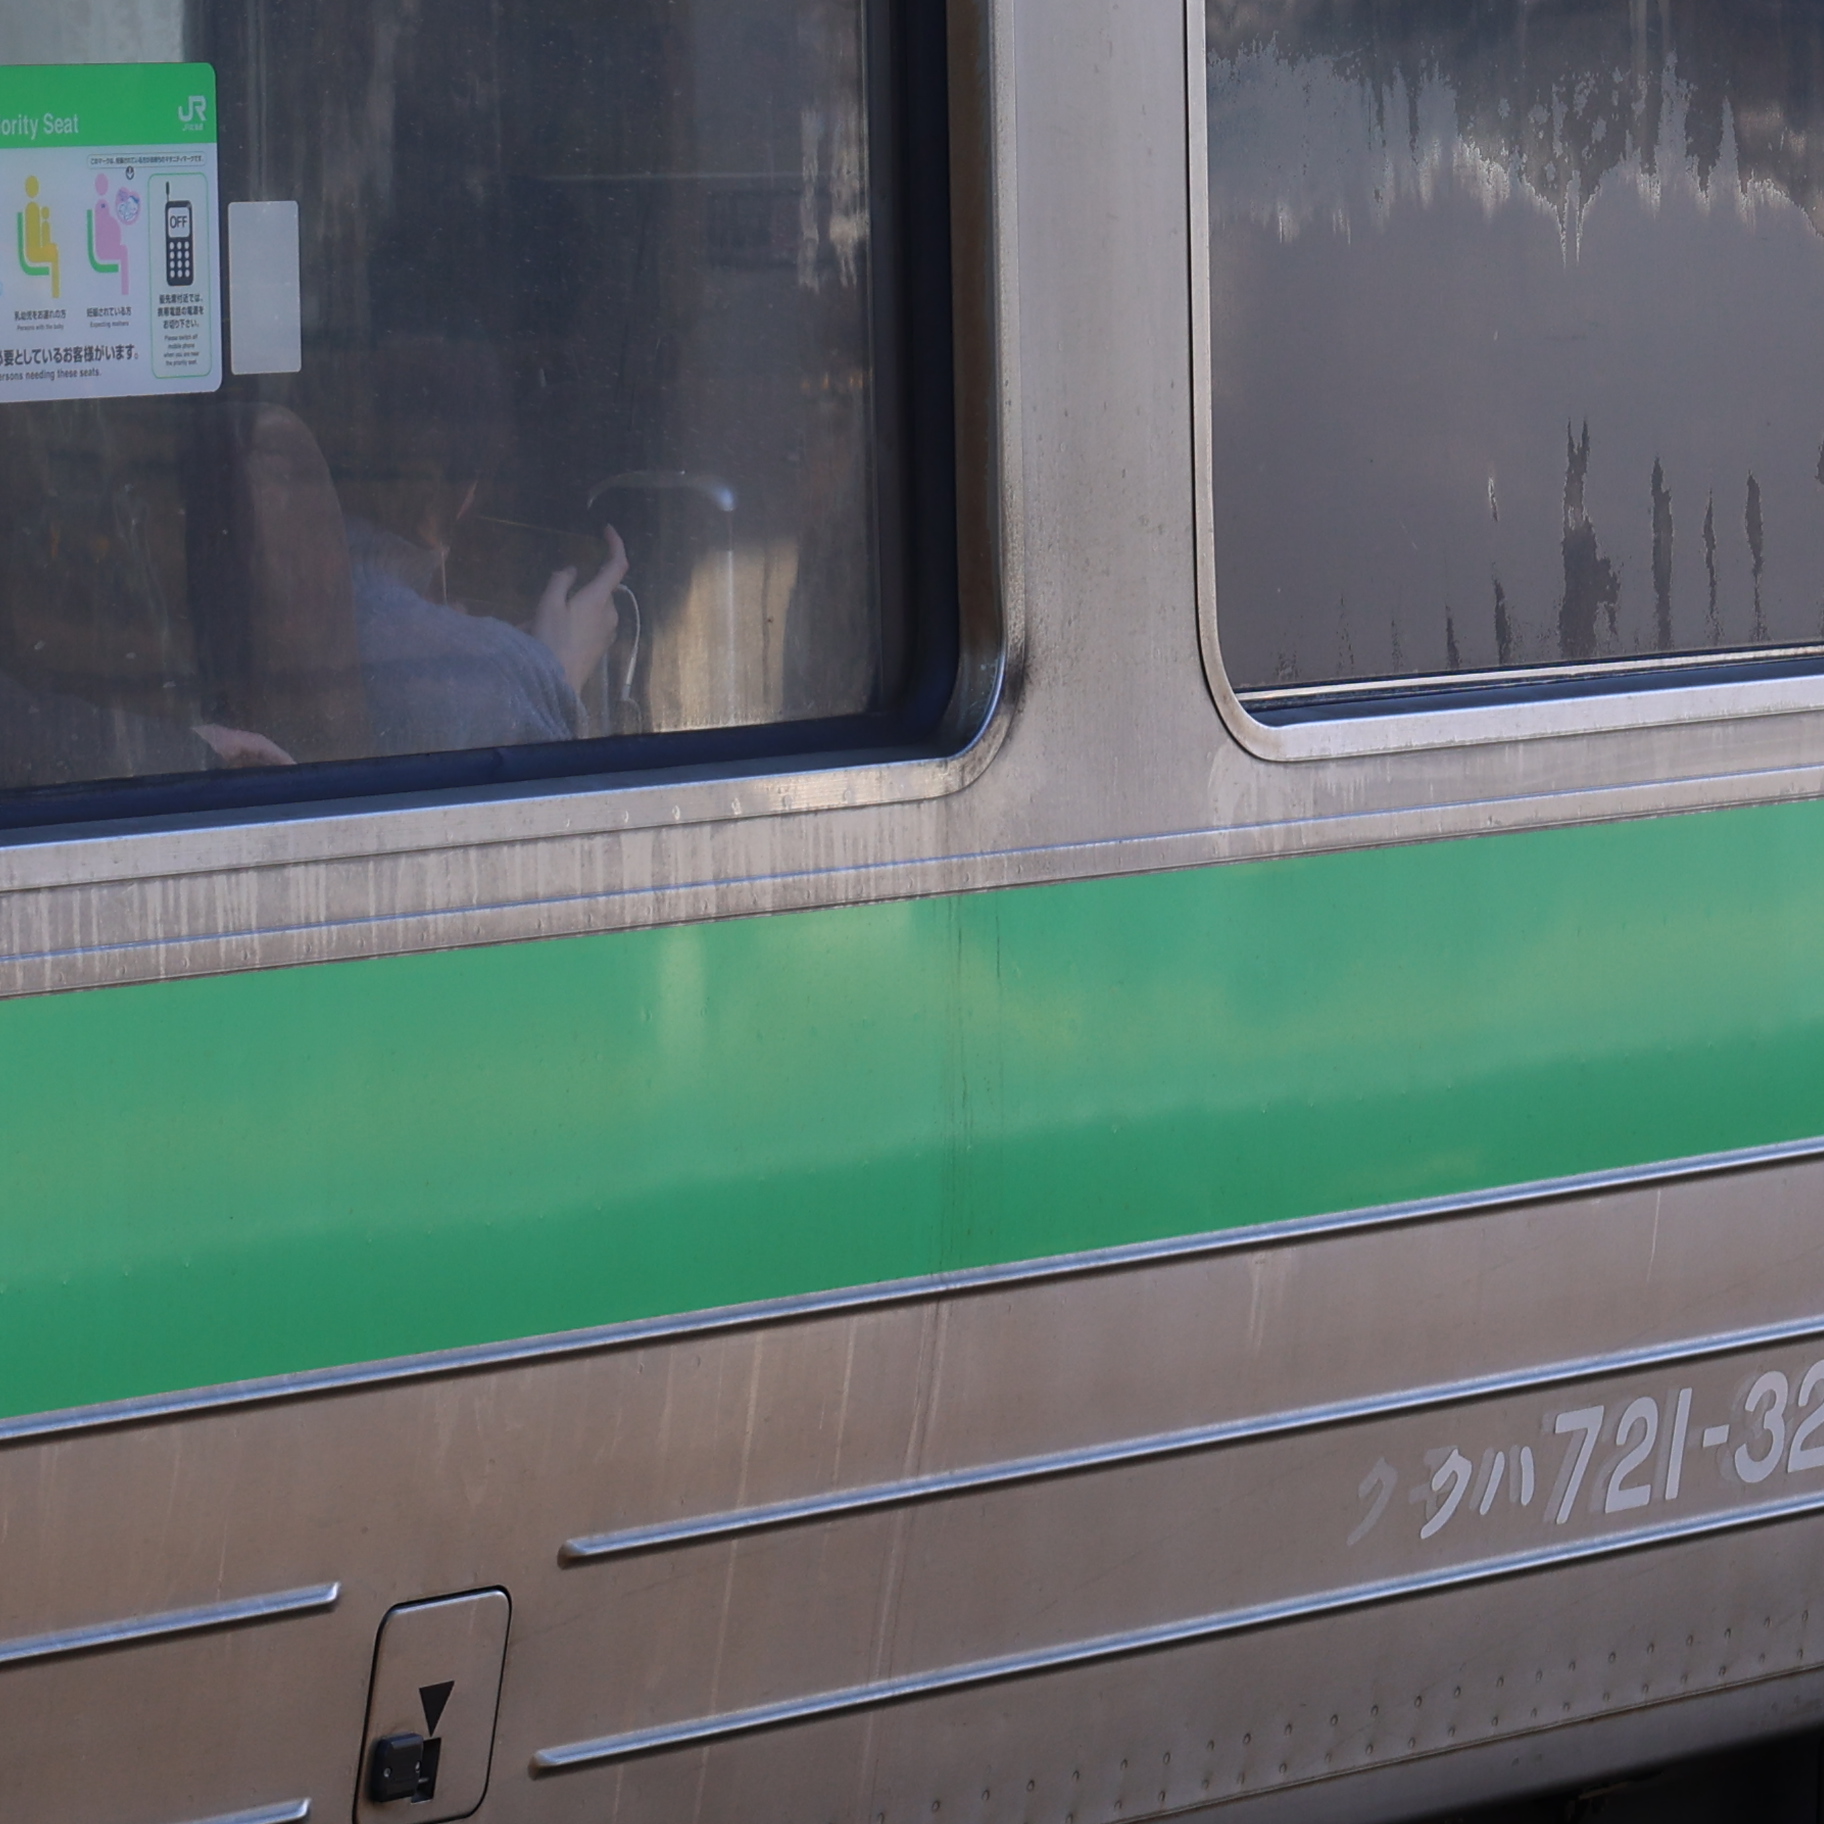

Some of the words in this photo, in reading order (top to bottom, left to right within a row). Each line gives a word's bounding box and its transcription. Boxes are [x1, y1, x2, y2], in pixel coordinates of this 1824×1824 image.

[178, 95, 207, 122] JR
[43, 112, 80, 135] Seat
[169, 215, 188, 229] OFF
[25, 369, 55, 381] needing
[57, 368, 78, 379] these
[79, 367, 102, 378] seats.
